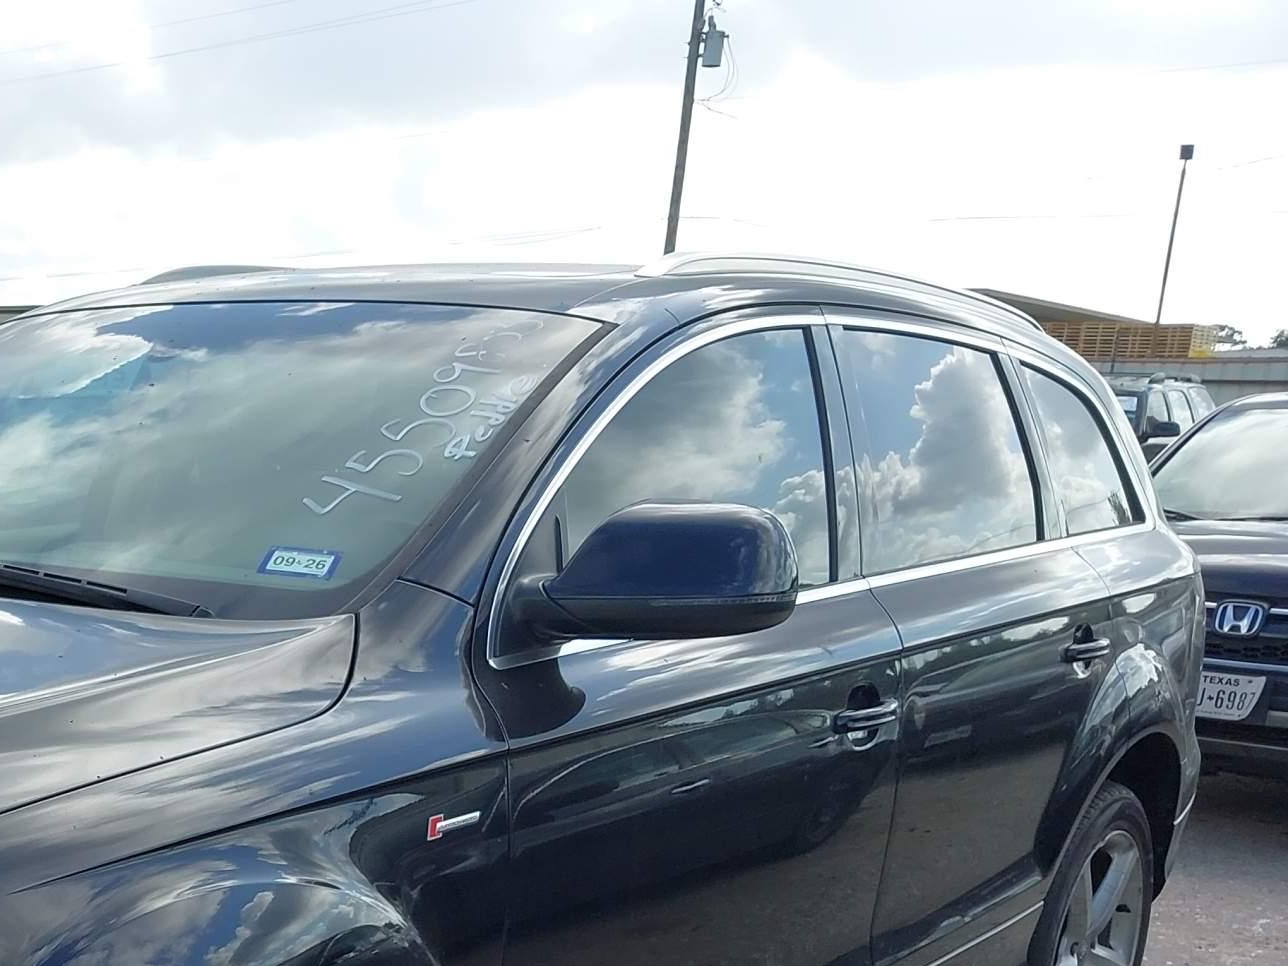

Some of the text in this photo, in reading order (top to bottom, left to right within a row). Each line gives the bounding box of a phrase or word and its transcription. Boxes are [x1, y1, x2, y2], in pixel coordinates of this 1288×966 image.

[303, 320, 544, 516] 45509
[273, 555, 328, 570] 09 26
[1202, 675, 1241, 688] TEXAS
